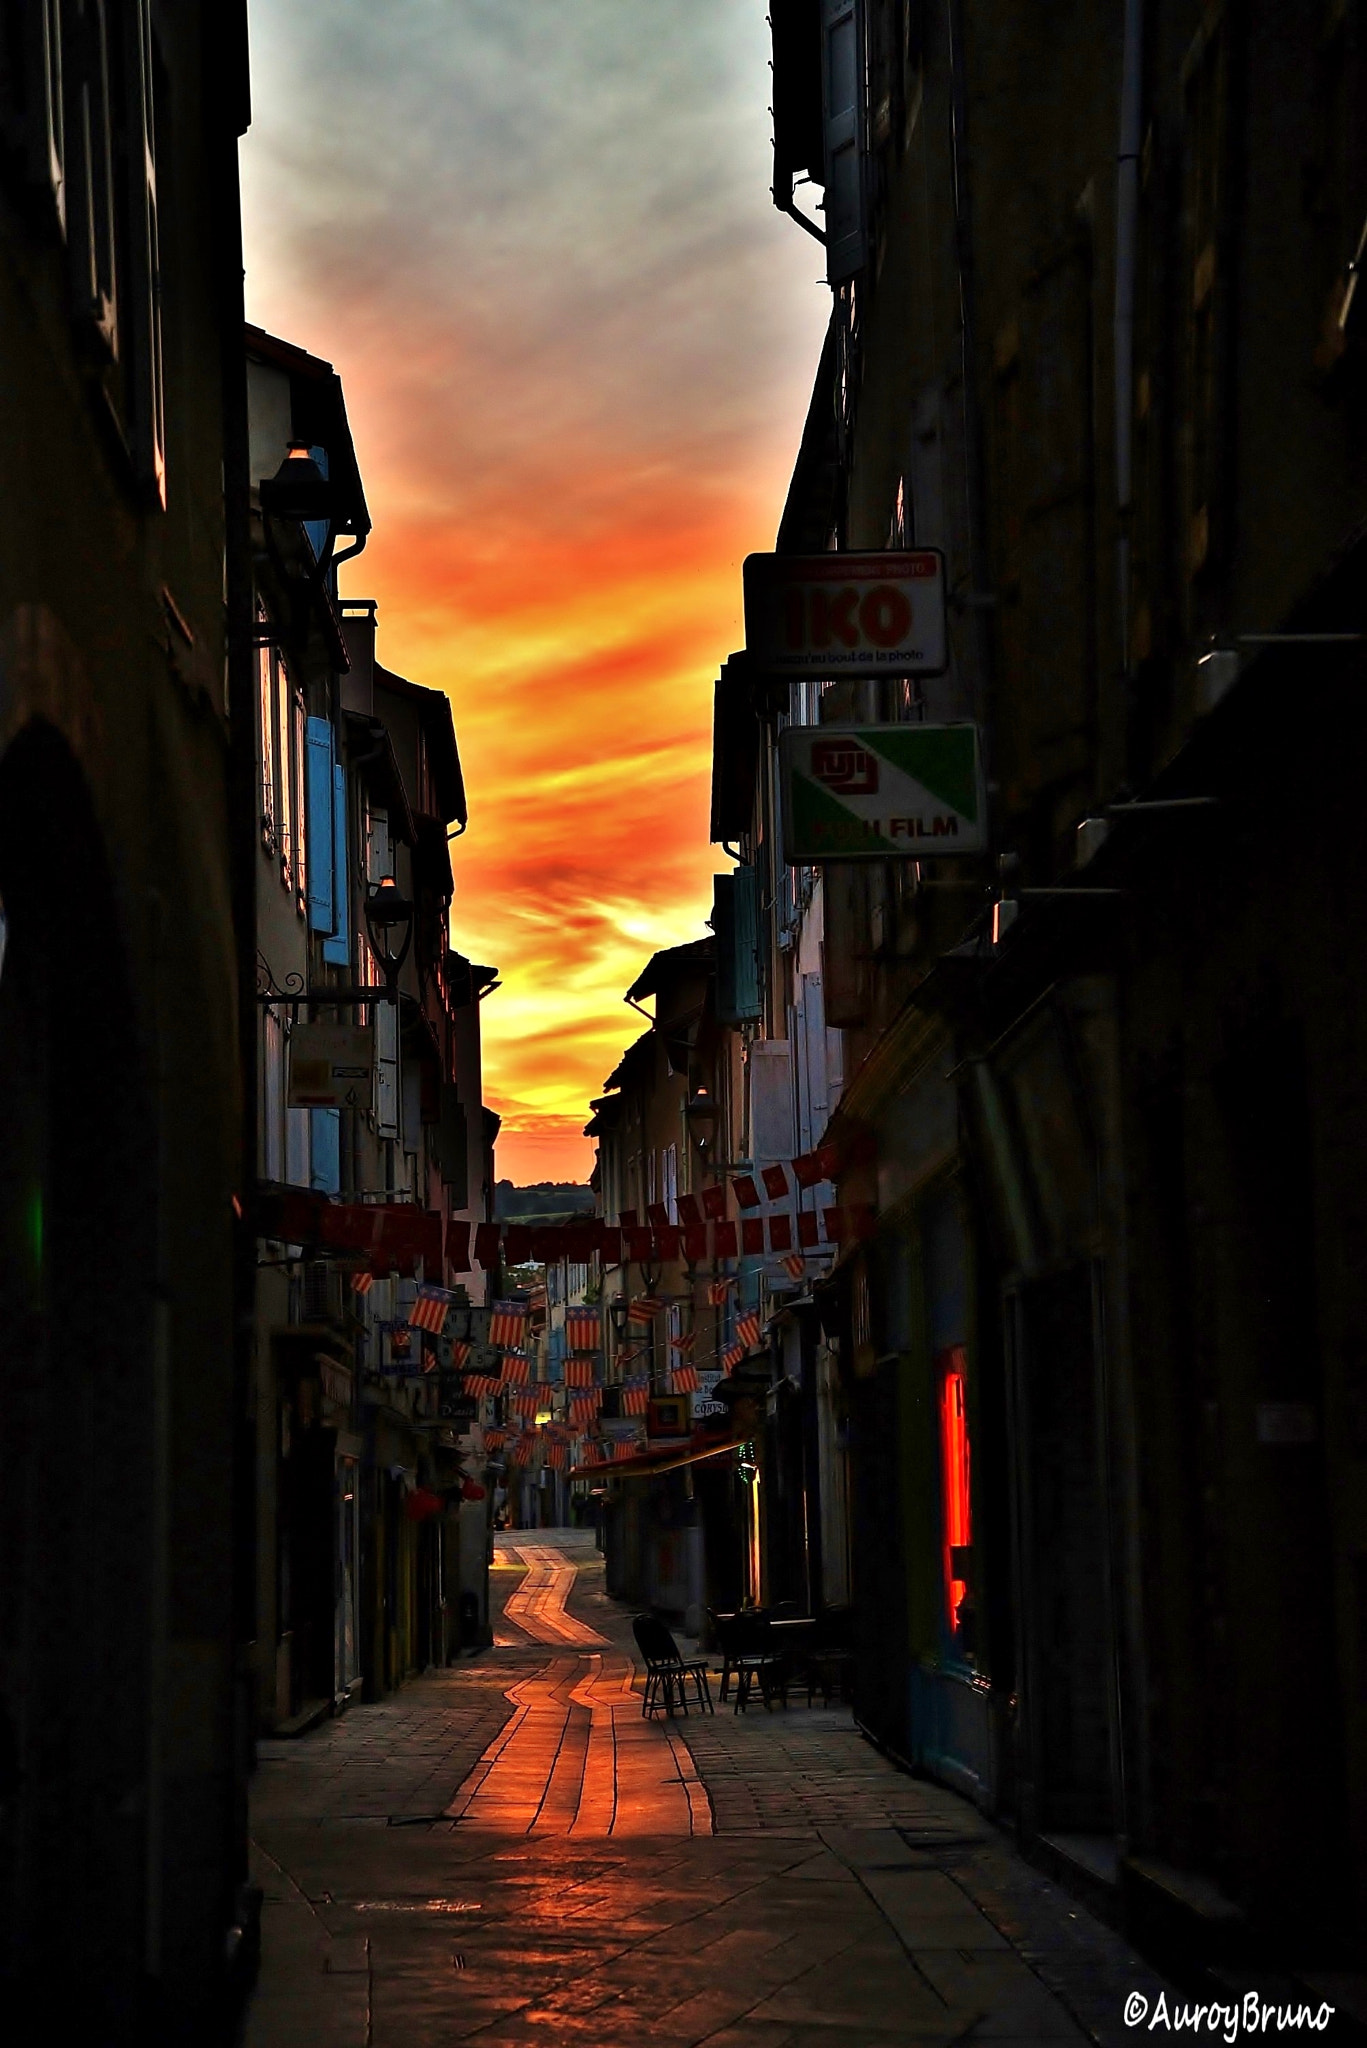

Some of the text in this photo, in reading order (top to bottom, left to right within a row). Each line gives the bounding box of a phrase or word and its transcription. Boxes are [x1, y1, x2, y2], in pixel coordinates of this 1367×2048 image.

[828, 651, 855, 664] bout
[889, 649, 923, 664] photo
[890, 816, 958, 838] FILM
